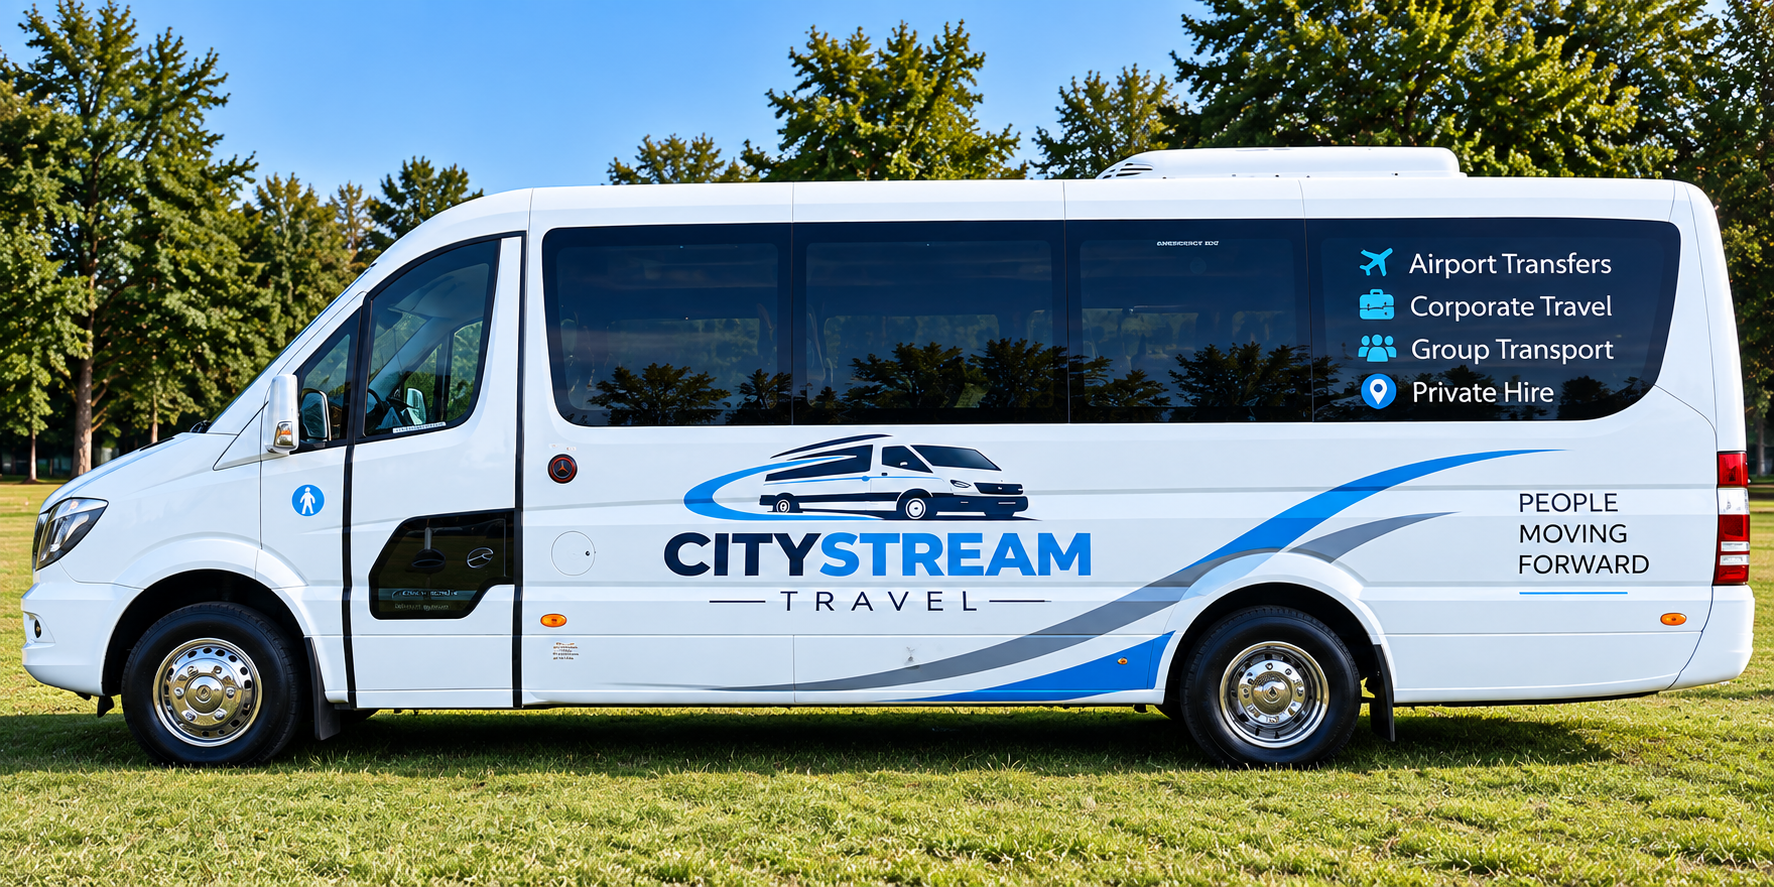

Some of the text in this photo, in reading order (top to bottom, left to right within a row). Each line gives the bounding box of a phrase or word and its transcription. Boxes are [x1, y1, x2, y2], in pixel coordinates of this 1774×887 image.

[1409, 252, 1612, 279] Airport Transfers
[1410, 295, 1613, 322] Corporate Travel
[1411, 338, 1615, 365] Group Transport
[1413, 382, 1554, 404] Private Hire
[1519, 493, 1619, 513] PEOPLE
[1519, 523, 1627, 544] MOVING
[663, 532, 1092, 577] CITYSTREAM
[1519, 554, 1650, 575] FORWARD
[780, 590, 978, 612] TRAVEL
